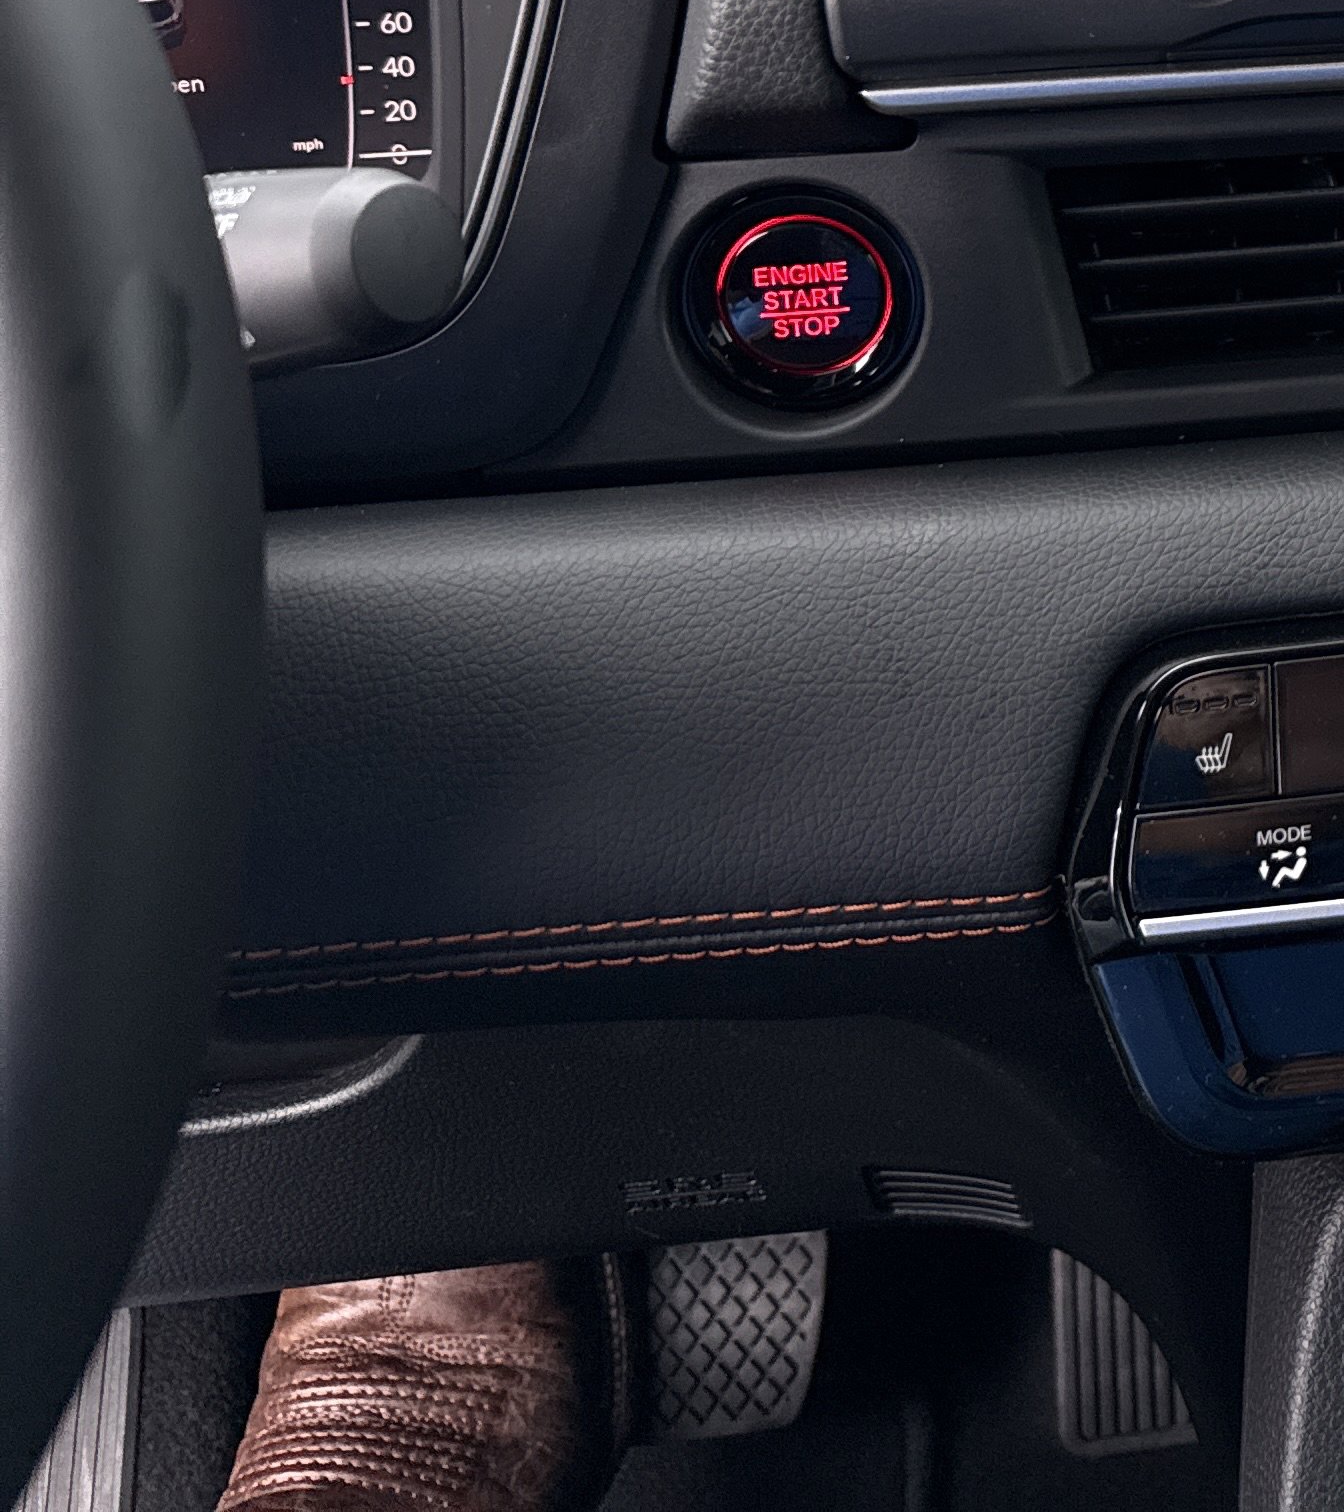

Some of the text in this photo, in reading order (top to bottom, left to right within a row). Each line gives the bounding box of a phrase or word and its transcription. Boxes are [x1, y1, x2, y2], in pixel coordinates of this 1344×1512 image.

[380, 11, 413, 34] 60
[381, 55, 416, 78] 40
[384, 99, 417, 122] 20
[292, 138, 324, 153] mph
[753, 260, 849, 288] ENGINE
[763, 286, 843, 311] START
[773, 315, 841, 339] STOP
[1256, 823, 1312, 847] MODE
